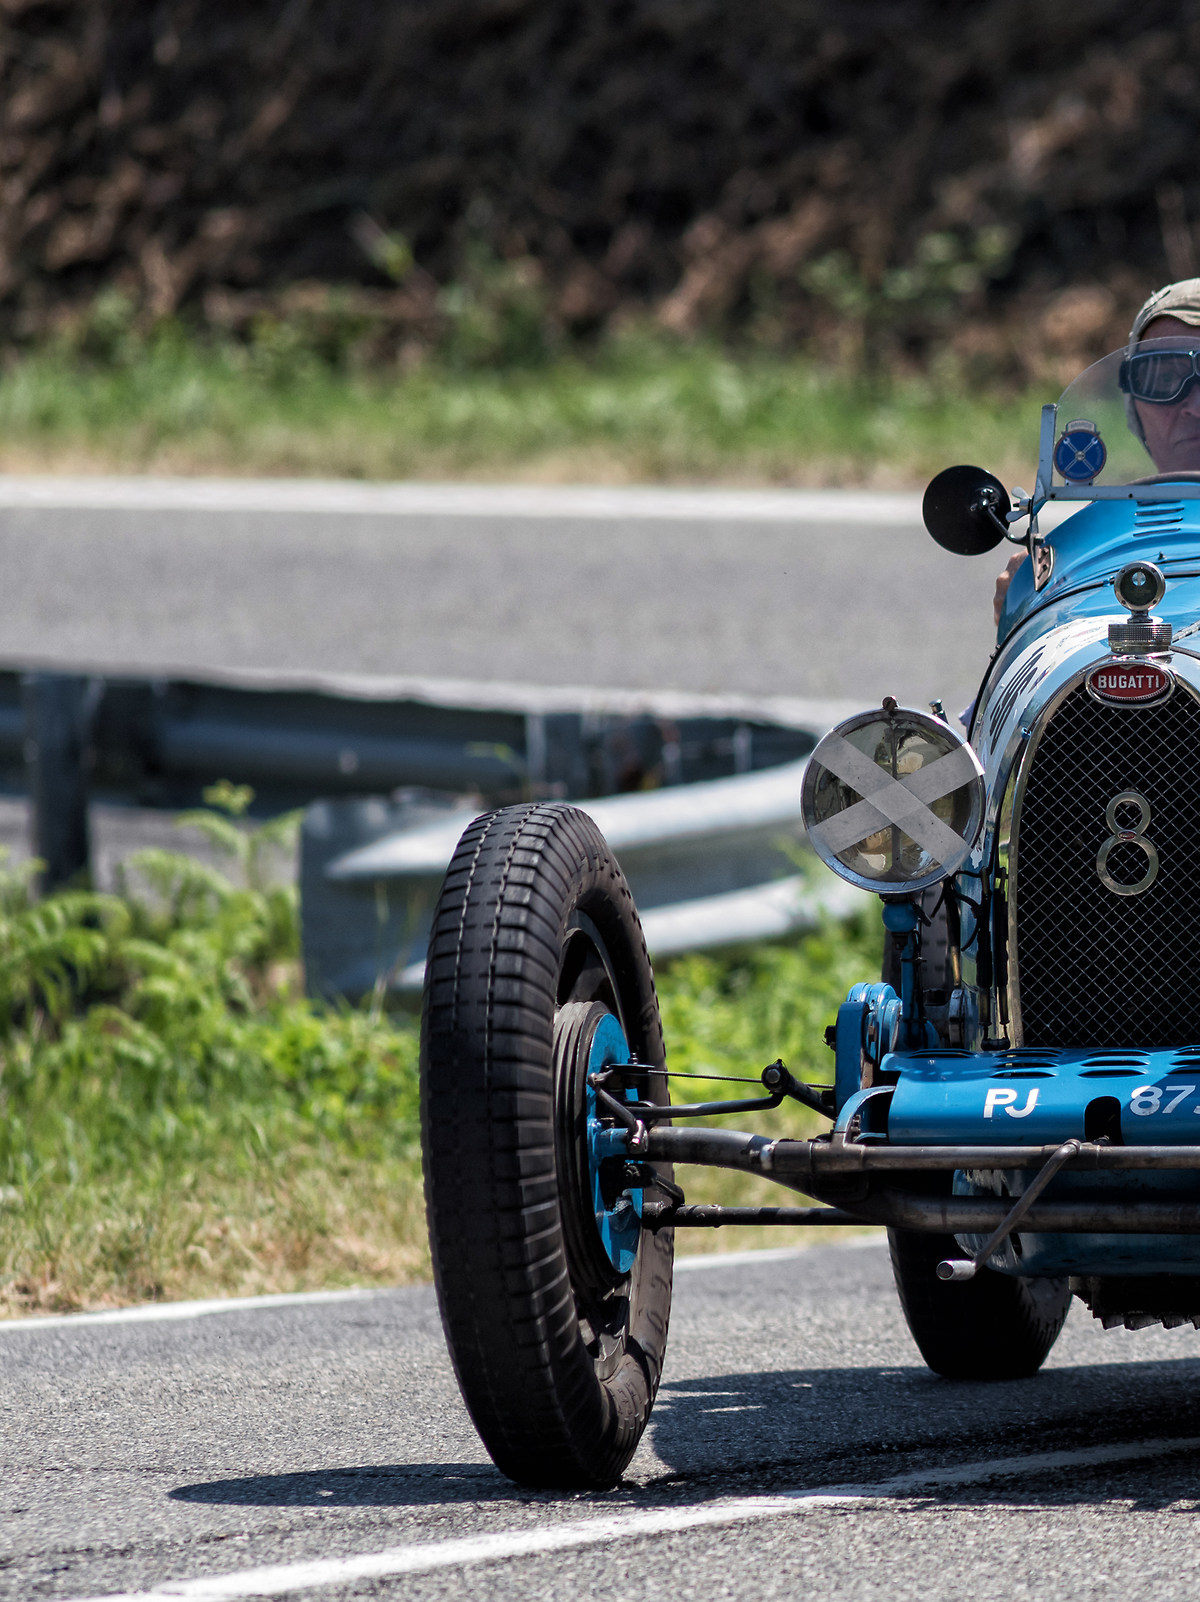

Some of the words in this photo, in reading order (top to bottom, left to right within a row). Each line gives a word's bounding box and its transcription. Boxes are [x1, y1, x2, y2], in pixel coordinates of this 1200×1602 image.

[1098, 674, 1160, 689] BUGATTI
[1096, 791, 1159, 896] 8
[983, 1088, 1039, 1118] PJ
